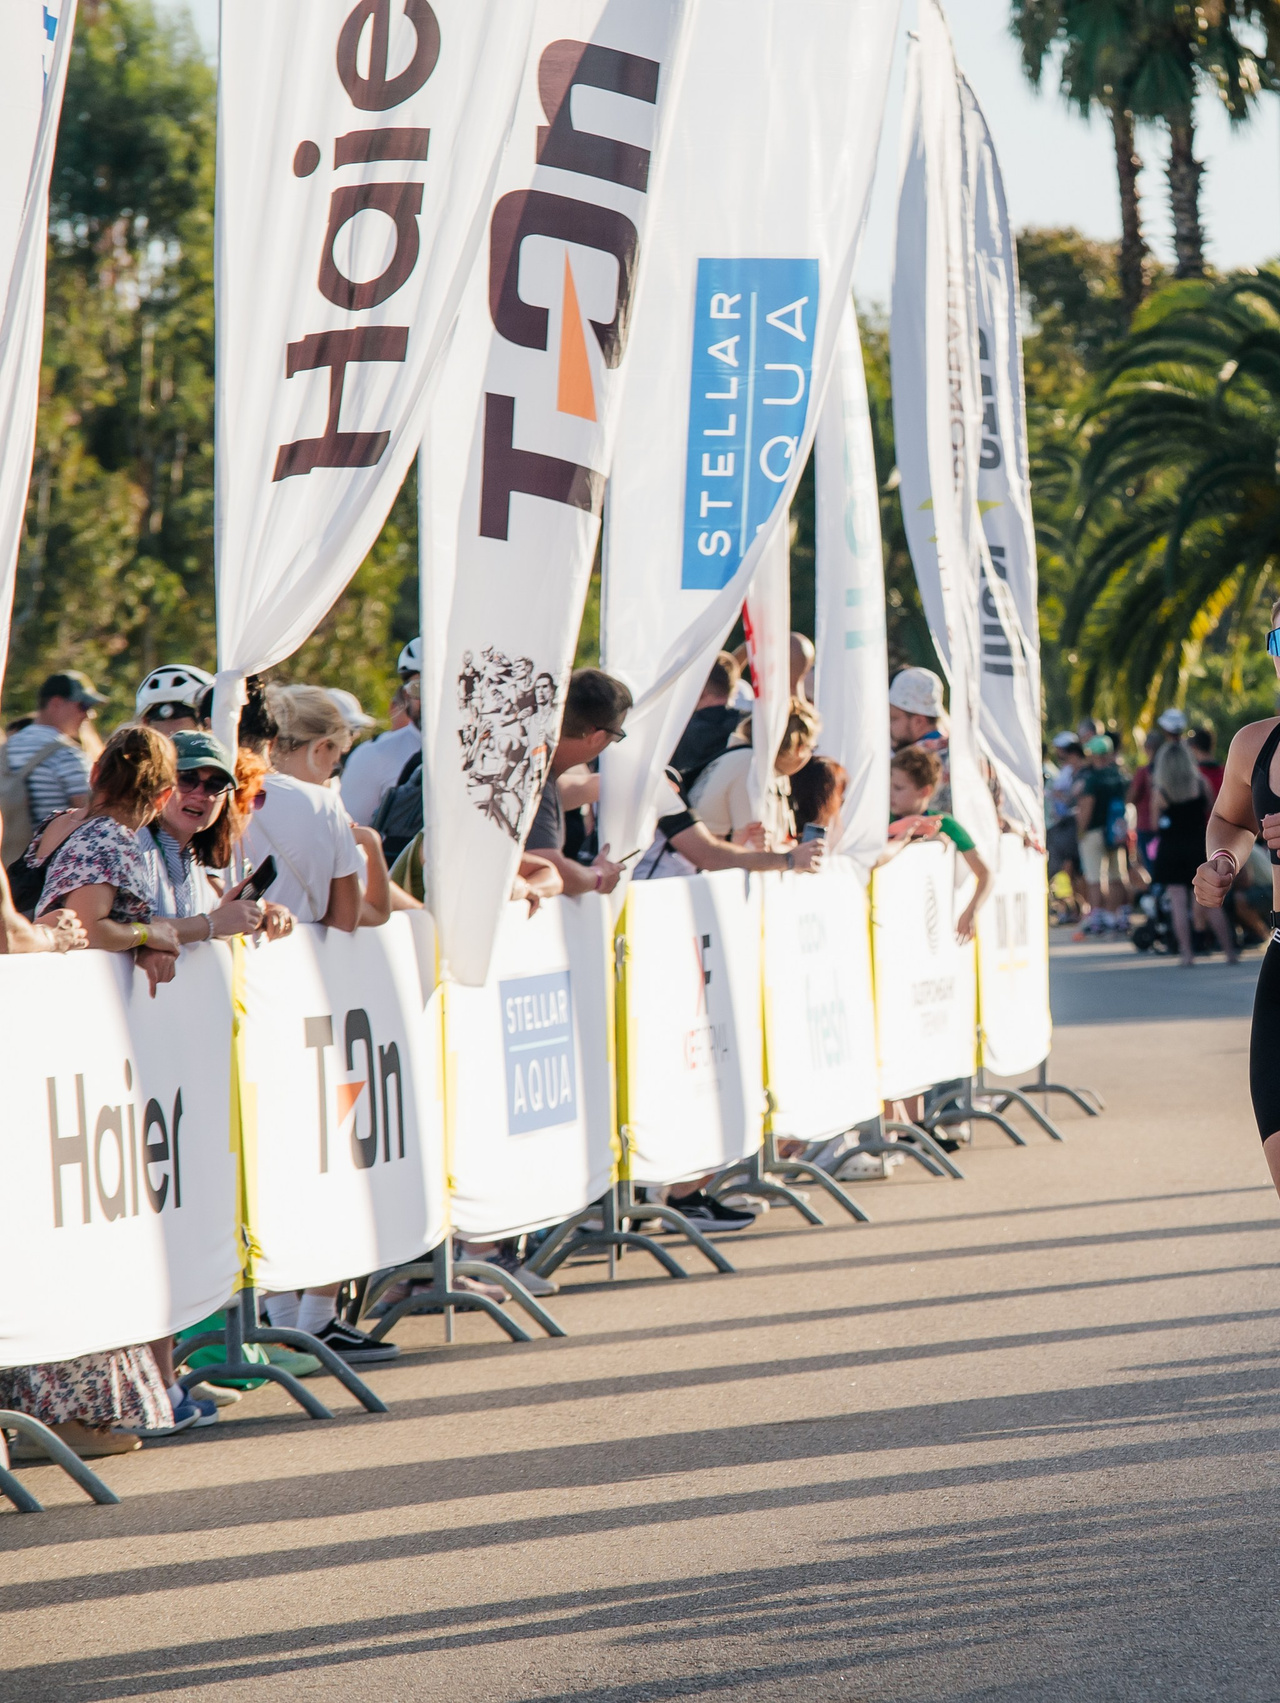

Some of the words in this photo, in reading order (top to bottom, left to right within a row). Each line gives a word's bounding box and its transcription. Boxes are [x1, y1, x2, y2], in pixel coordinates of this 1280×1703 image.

[698, 293, 742, 557] STELLAR
[756, 296, 809, 534] QUA
[506, 989, 568, 1034] STELLAR
[514, 1053, 572, 1116] AQUA
[46, 1058, 183, 1229] Haier
